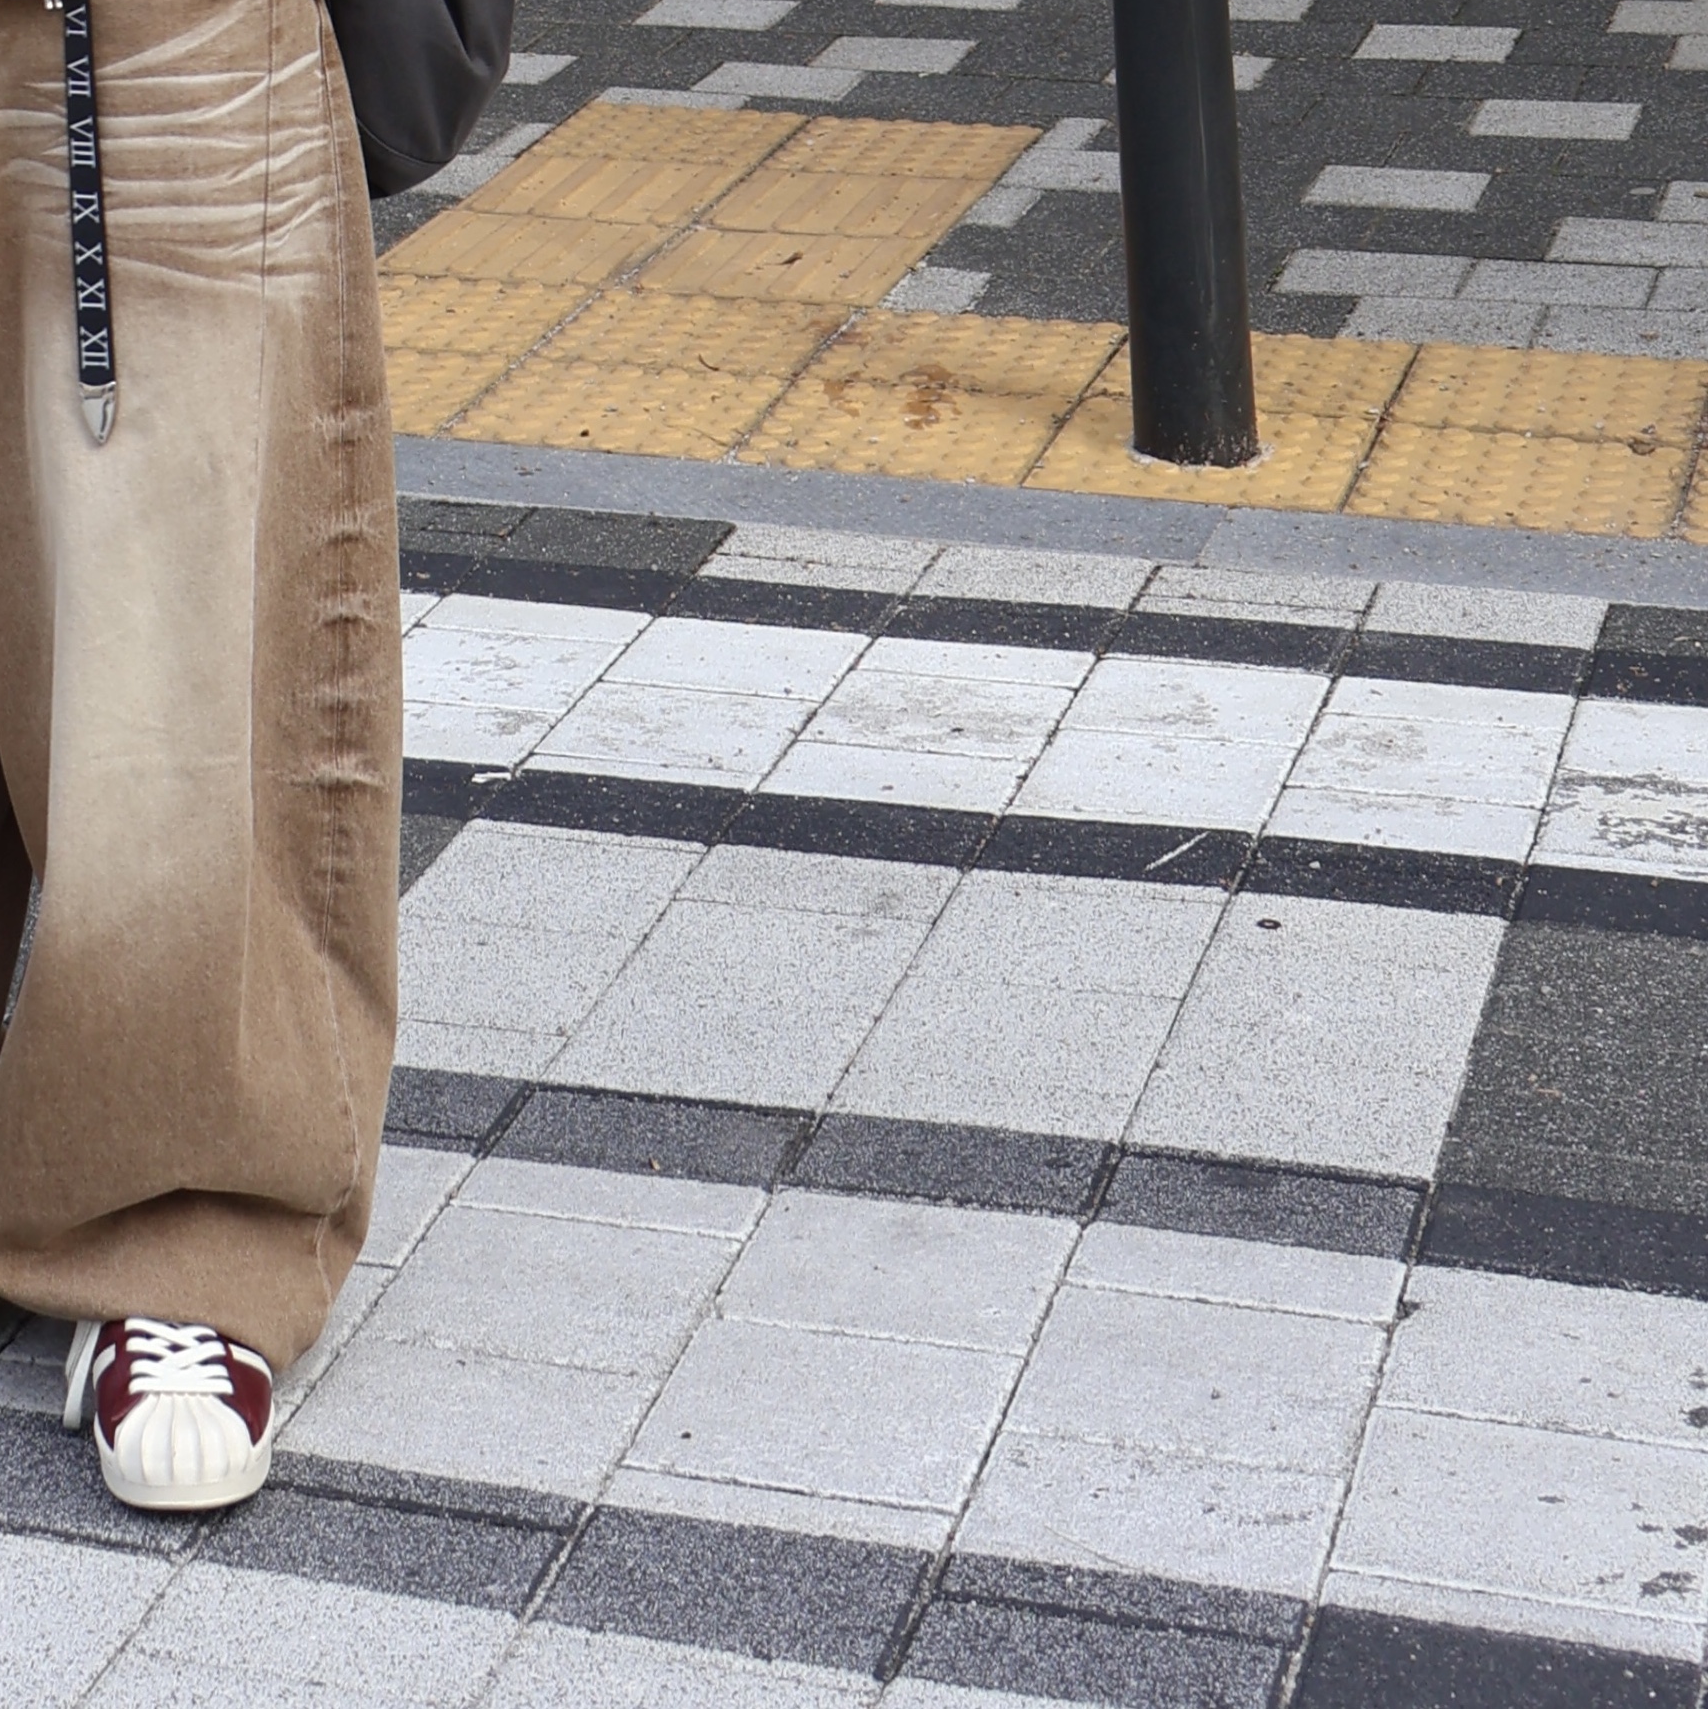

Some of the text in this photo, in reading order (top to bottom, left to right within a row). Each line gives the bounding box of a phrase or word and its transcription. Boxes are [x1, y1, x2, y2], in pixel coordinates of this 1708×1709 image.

[65, 4, 109, 370] VI VII VIII IX X XI XII
